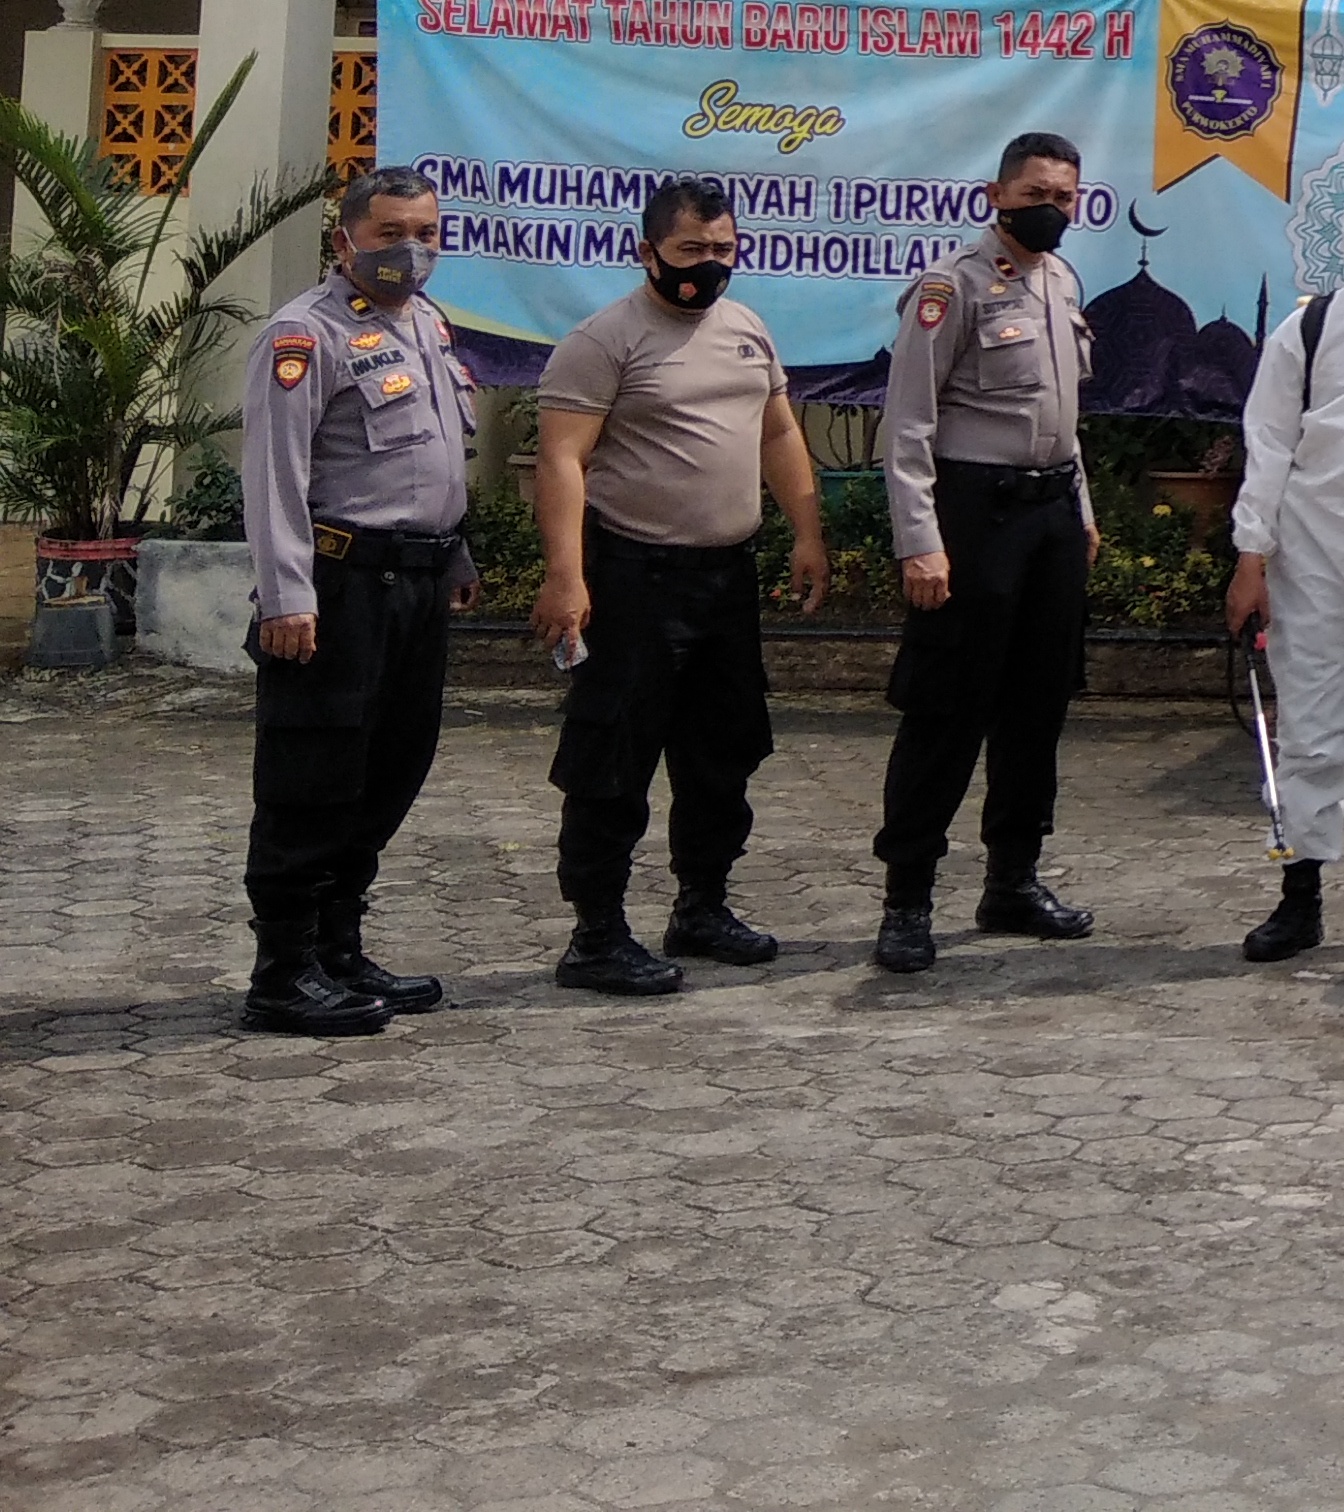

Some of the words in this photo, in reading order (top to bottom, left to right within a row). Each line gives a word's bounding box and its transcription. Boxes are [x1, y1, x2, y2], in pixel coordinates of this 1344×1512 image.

[742, 2, 848, 54] BARU
[858, 7, 982, 58] ISLAM
[993, 10, 1096, 59] 1442
[1104, 10, 1135, 59] H
[684, 80, 845, 153] Semoga
[415, 158, 490, 201] SMA
[499, 165, 814, 219] MUHAMIYAH
[831, 181, 844, 220] 1
[853, 182, 1113, 227] PURWOTO
[441, 214, 572, 262] EMAKIN
